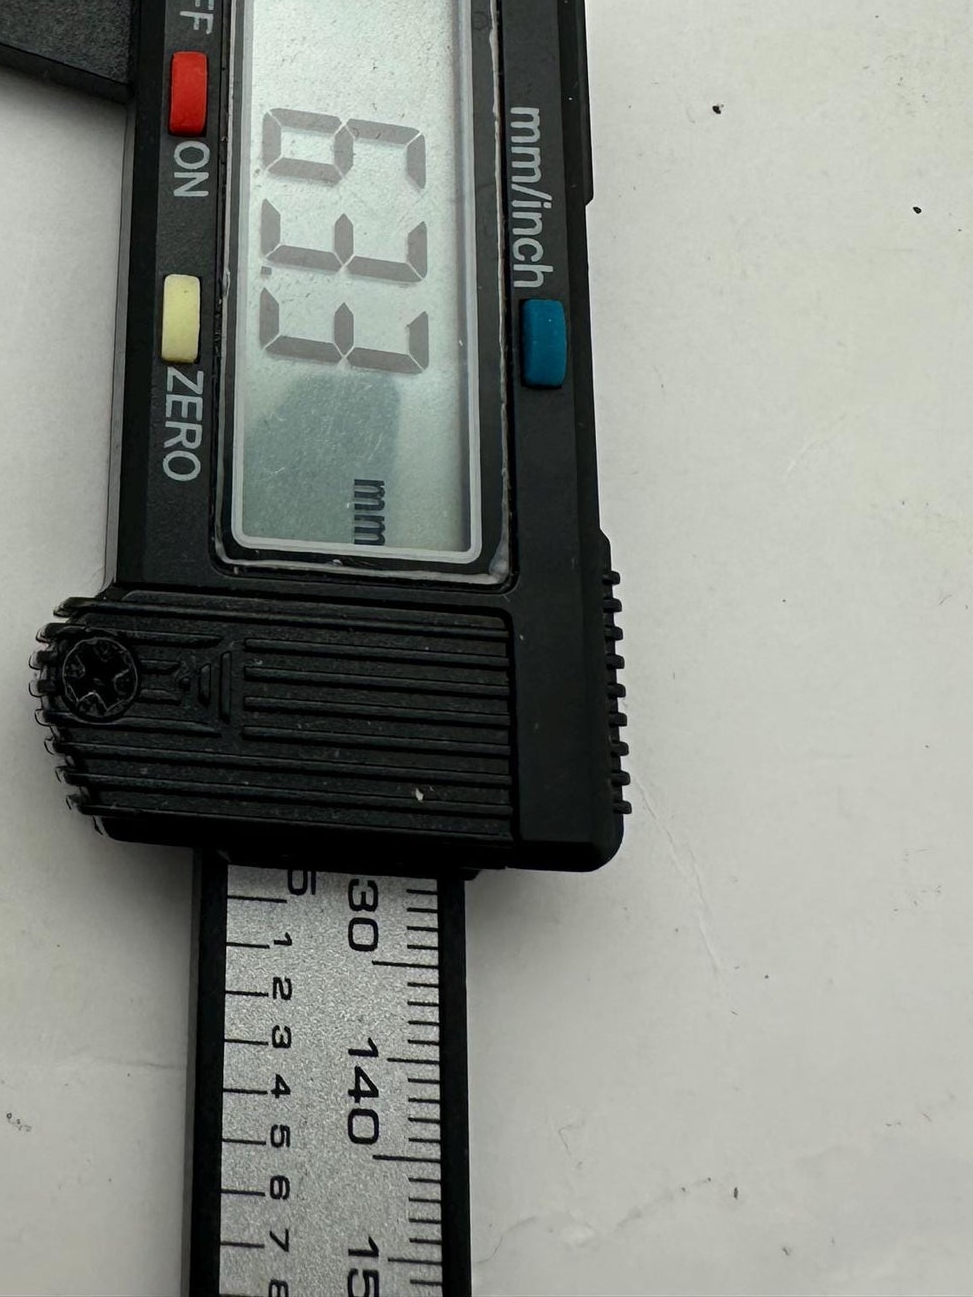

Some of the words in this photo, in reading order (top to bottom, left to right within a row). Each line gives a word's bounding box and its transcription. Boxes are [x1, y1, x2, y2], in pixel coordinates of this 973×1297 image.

[173, 140, 210, 198] ON
[509, 106, 554, 289] mm/inch
[162, 366, 205, 483] ZERO
[353, 478, 385, 547] mm
[347, 878, 379, 952] 30
[273, 932, 293, 946] 1
[272, 976, 293, 1002] 2
[271, 1024, 293, 1050] 3
[270, 1073, 292, 1100] 4
[347, 1036, 380, 1146] 140
[269, 1123, 291, 1150] 5
[269, 1174, 291, 1201] 6
[268, 1227, 290, 1253] 7
[347, 1234, 380, 1297] 15
